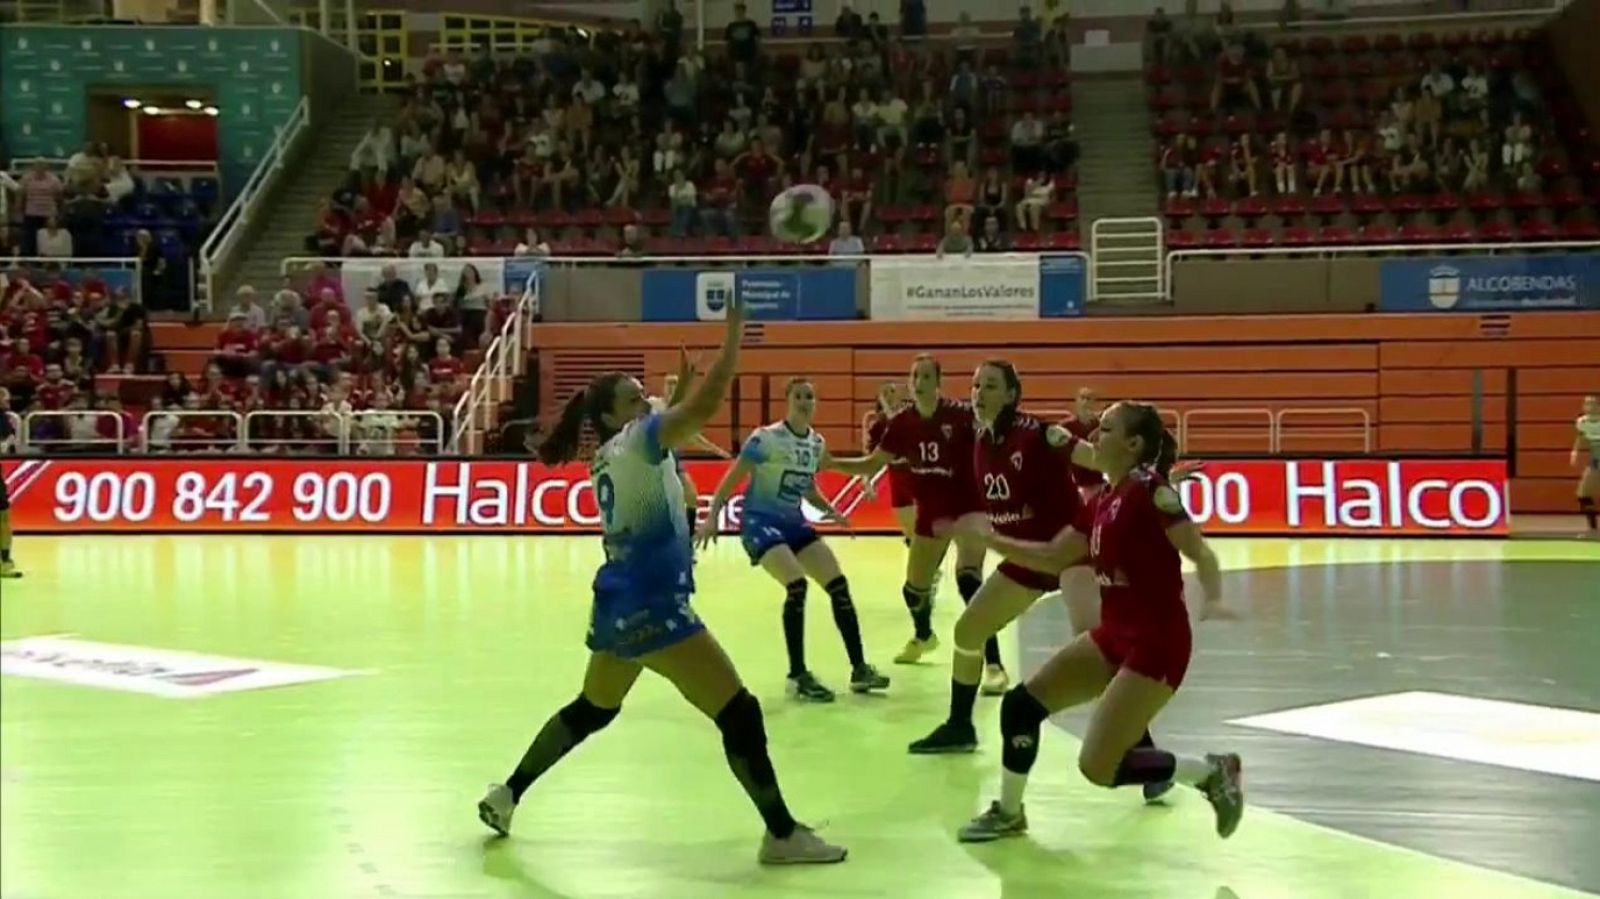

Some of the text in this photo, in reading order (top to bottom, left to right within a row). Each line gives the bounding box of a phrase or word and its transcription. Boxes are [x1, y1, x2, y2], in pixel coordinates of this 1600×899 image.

[906, 283, 1035, 300] #GananLosValores
[1466, 274, 1576, 292] ALCOBENDAS
[918, 441, 939, 462] 13
[53, 472, 155, 523] 900
[171, 472, 274, 523] 842
[291, 472, 391, 522] 900
[422, 462, 600, 527] Halco
[597, 473, 615, 525] 9
[983, 472, 1011, 500] 20
[1180, 461, 1504, 529] 00 Halco
